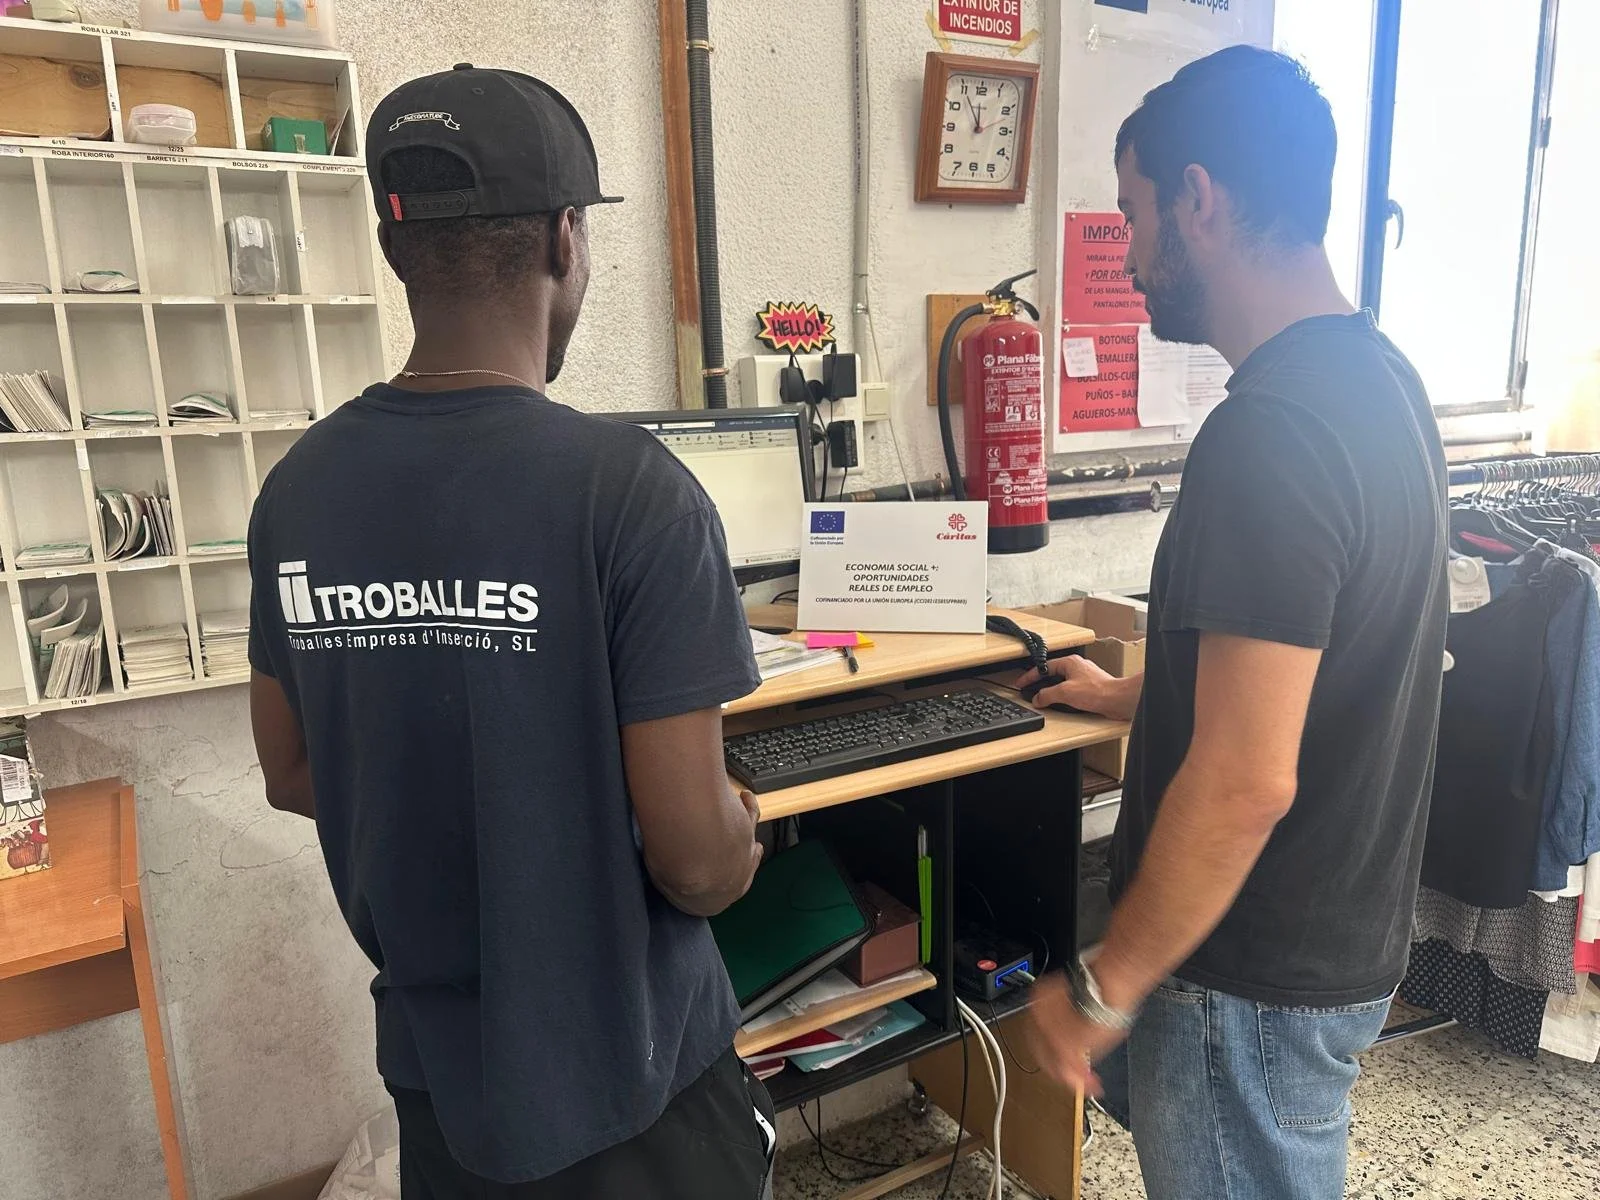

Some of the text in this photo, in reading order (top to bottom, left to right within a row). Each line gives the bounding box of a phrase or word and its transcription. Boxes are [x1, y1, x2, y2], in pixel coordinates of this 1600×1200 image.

[1003, 0, 1018, 16] DE
[949, 12, 1012, 35] INCENDIOS
[961, 85, 968, 95] 11
[975, 86, 987, 96] 12
[949, 101, 961, 111] 10
[1001, 106, 1011, 115] 2
[946, 122, 956, 132] 9
[999, 127, 1008, 136] 3
[51, 149, 71, 157] ROBA
[944, 144, 953, 153] 8
[996, 147, 1006, 157] 4
[232, 161, 257, 169] BOLSOS
[953, 161, 962, 170] 7
[969, 162, 978, 171] 6
[986, 163, 995, 172] 5
[1082, 225, 1132, 241] IMPOR
[1090, 269, 1108, 280] POR
[1084, 287, 1093, 295] DE
[1094, 287, 1104, 295] LAS
[1105, 287, 1130, 295] MANGAS
[1093, 301, 1129, 309] PANTALONES
[771, 318, 823, 337] HELLO!
[1098, 335, 1136, 345] BOTONES
[997, 355, 1025, 365] Plana
[1096, 353, 1138, 364] REMALLERA
[1085, 388, 1114, 400] PUÑOS
[1121, 389, 1138, 398] BAJ
[845, 563, 895, 572] ECONOMIA
[897, 564, 929, 572] SOCIAL
[853, 574, 929, 582] OPORTUNIDADES
[848, 584, 880, 592] REALES
[896, 585, 933, 593] EMPLEO
[314, 579, 539, 623] TROBALLES
[288, 634, 343, 651] Troballes
[347, 632, 417, 651] Empresa
[511, 635, 537, 652] SL
